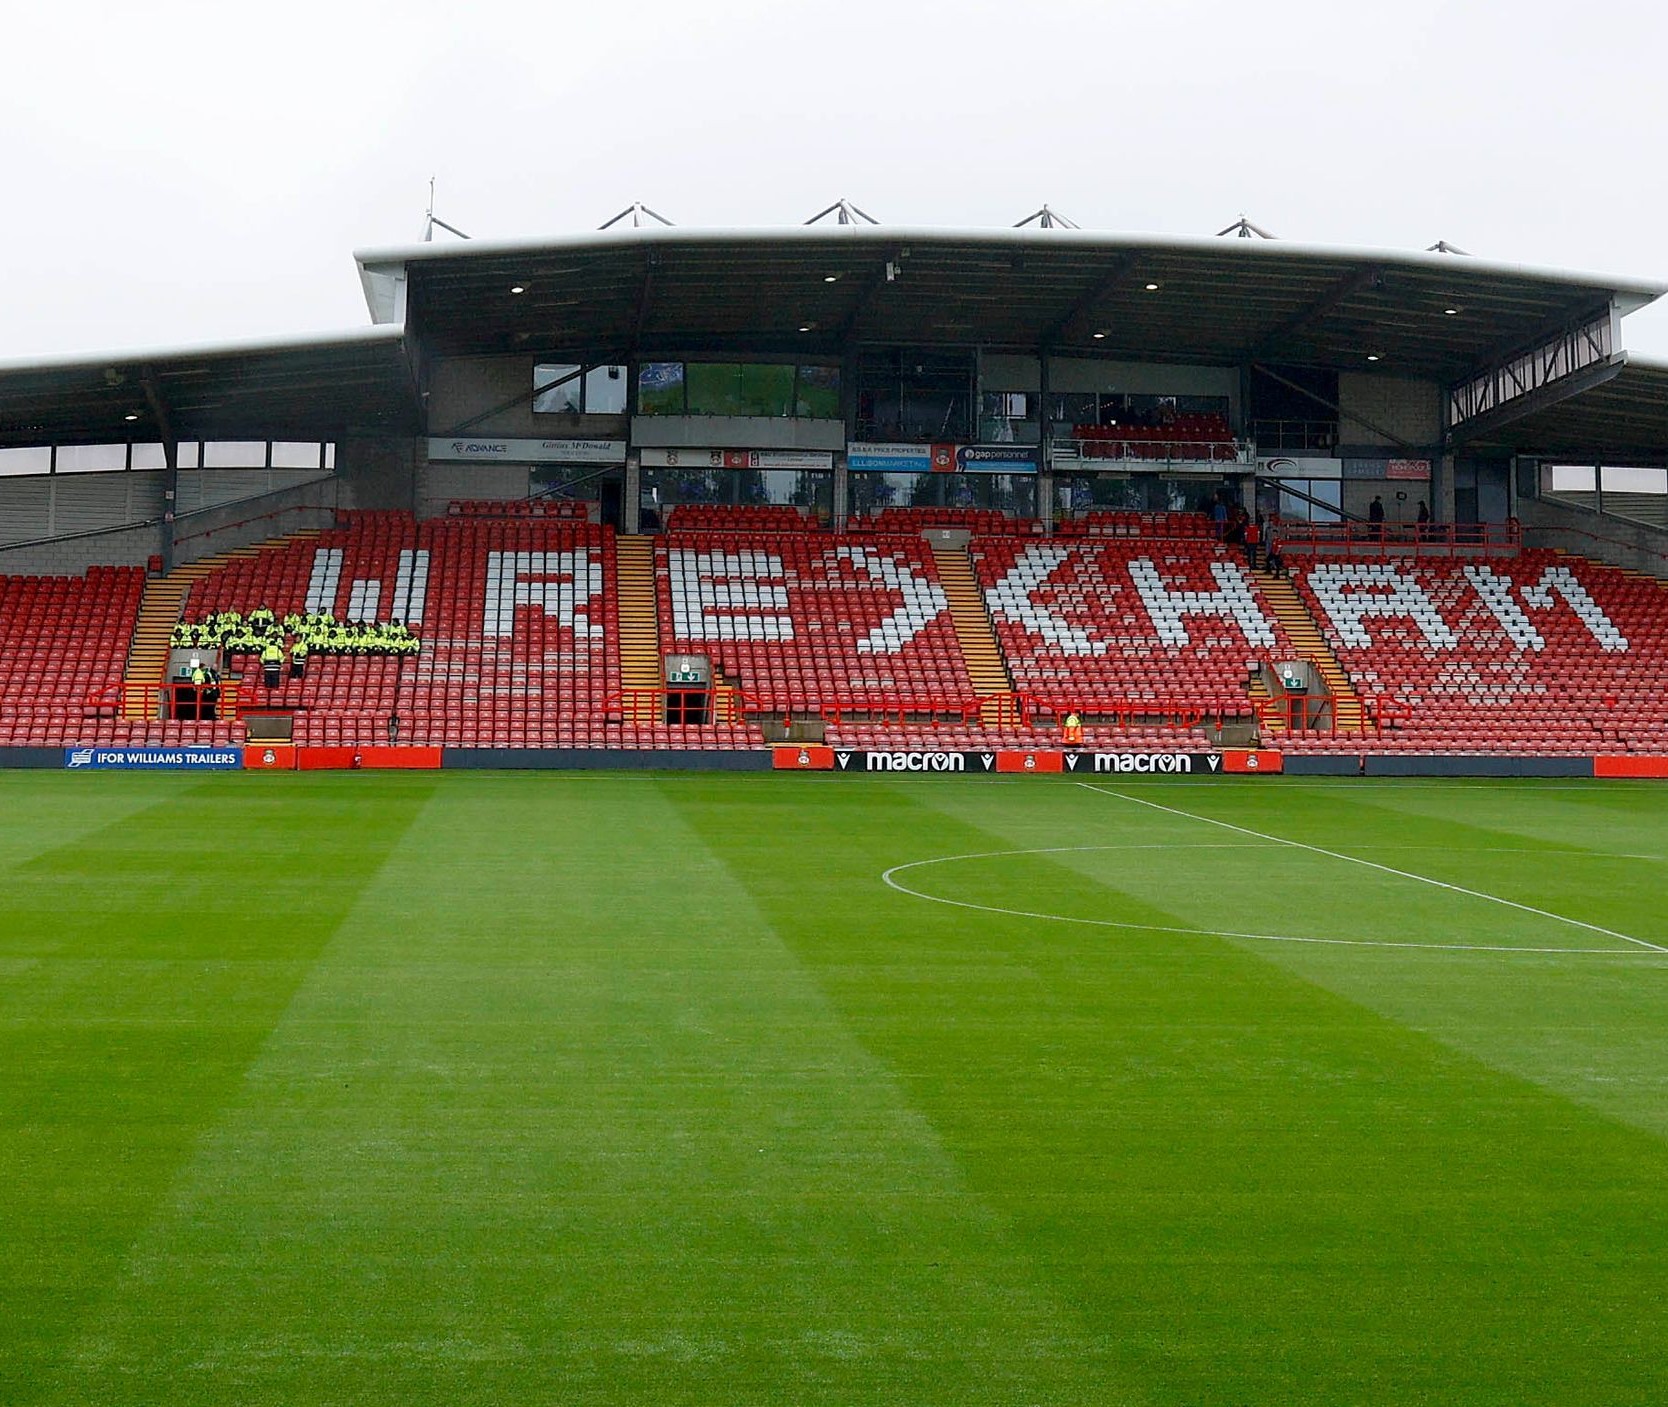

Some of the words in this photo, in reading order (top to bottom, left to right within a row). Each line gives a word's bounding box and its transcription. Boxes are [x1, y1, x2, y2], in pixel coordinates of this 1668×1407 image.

[97, 752, 125, 763] IFOR
[126, 752, 183, 764] WILLIAMS
[185, 753, 236, 764] TRAILERS
[866, 752, 965, 771] macron
[1094, 753, 1192, 773] macron
